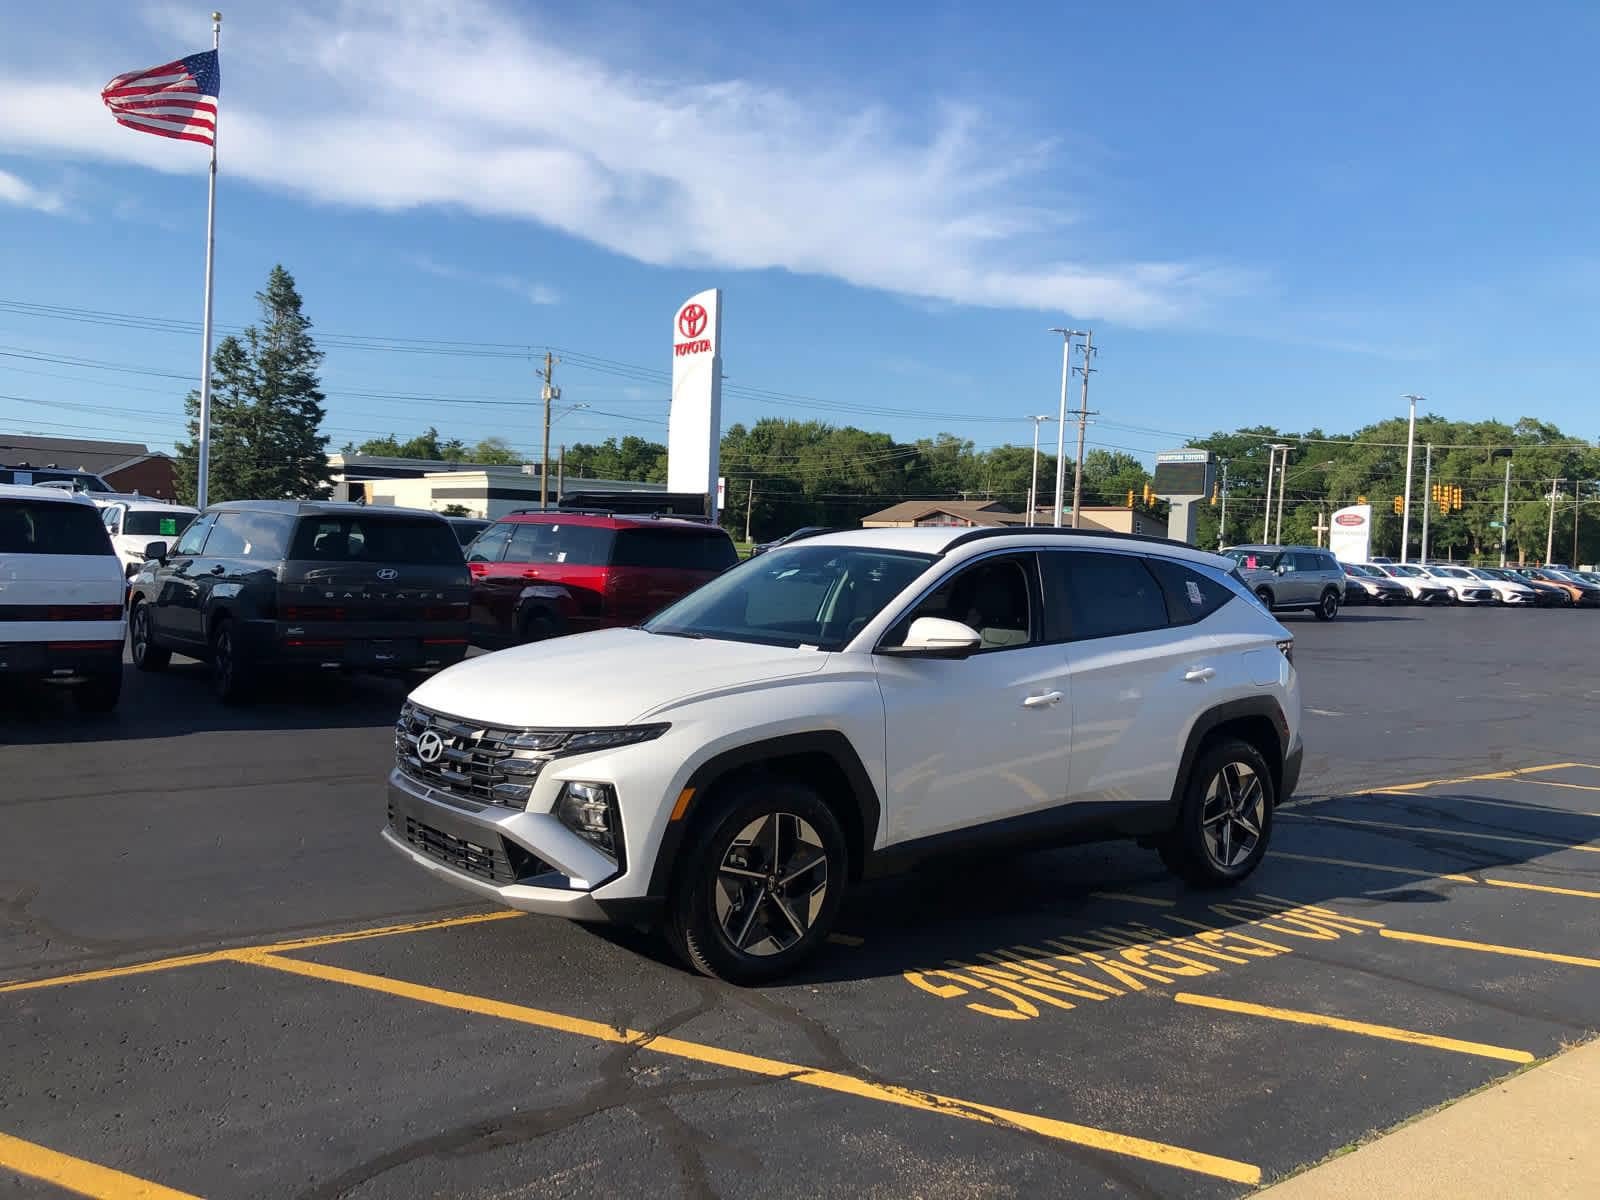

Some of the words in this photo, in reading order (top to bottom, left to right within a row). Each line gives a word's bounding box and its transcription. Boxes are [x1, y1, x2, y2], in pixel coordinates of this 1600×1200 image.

[674, 339, 712, 357] TOYOTA
[1208, 894, 1387, 940] NO
[903, 914, 1293, 1020] PARKING
